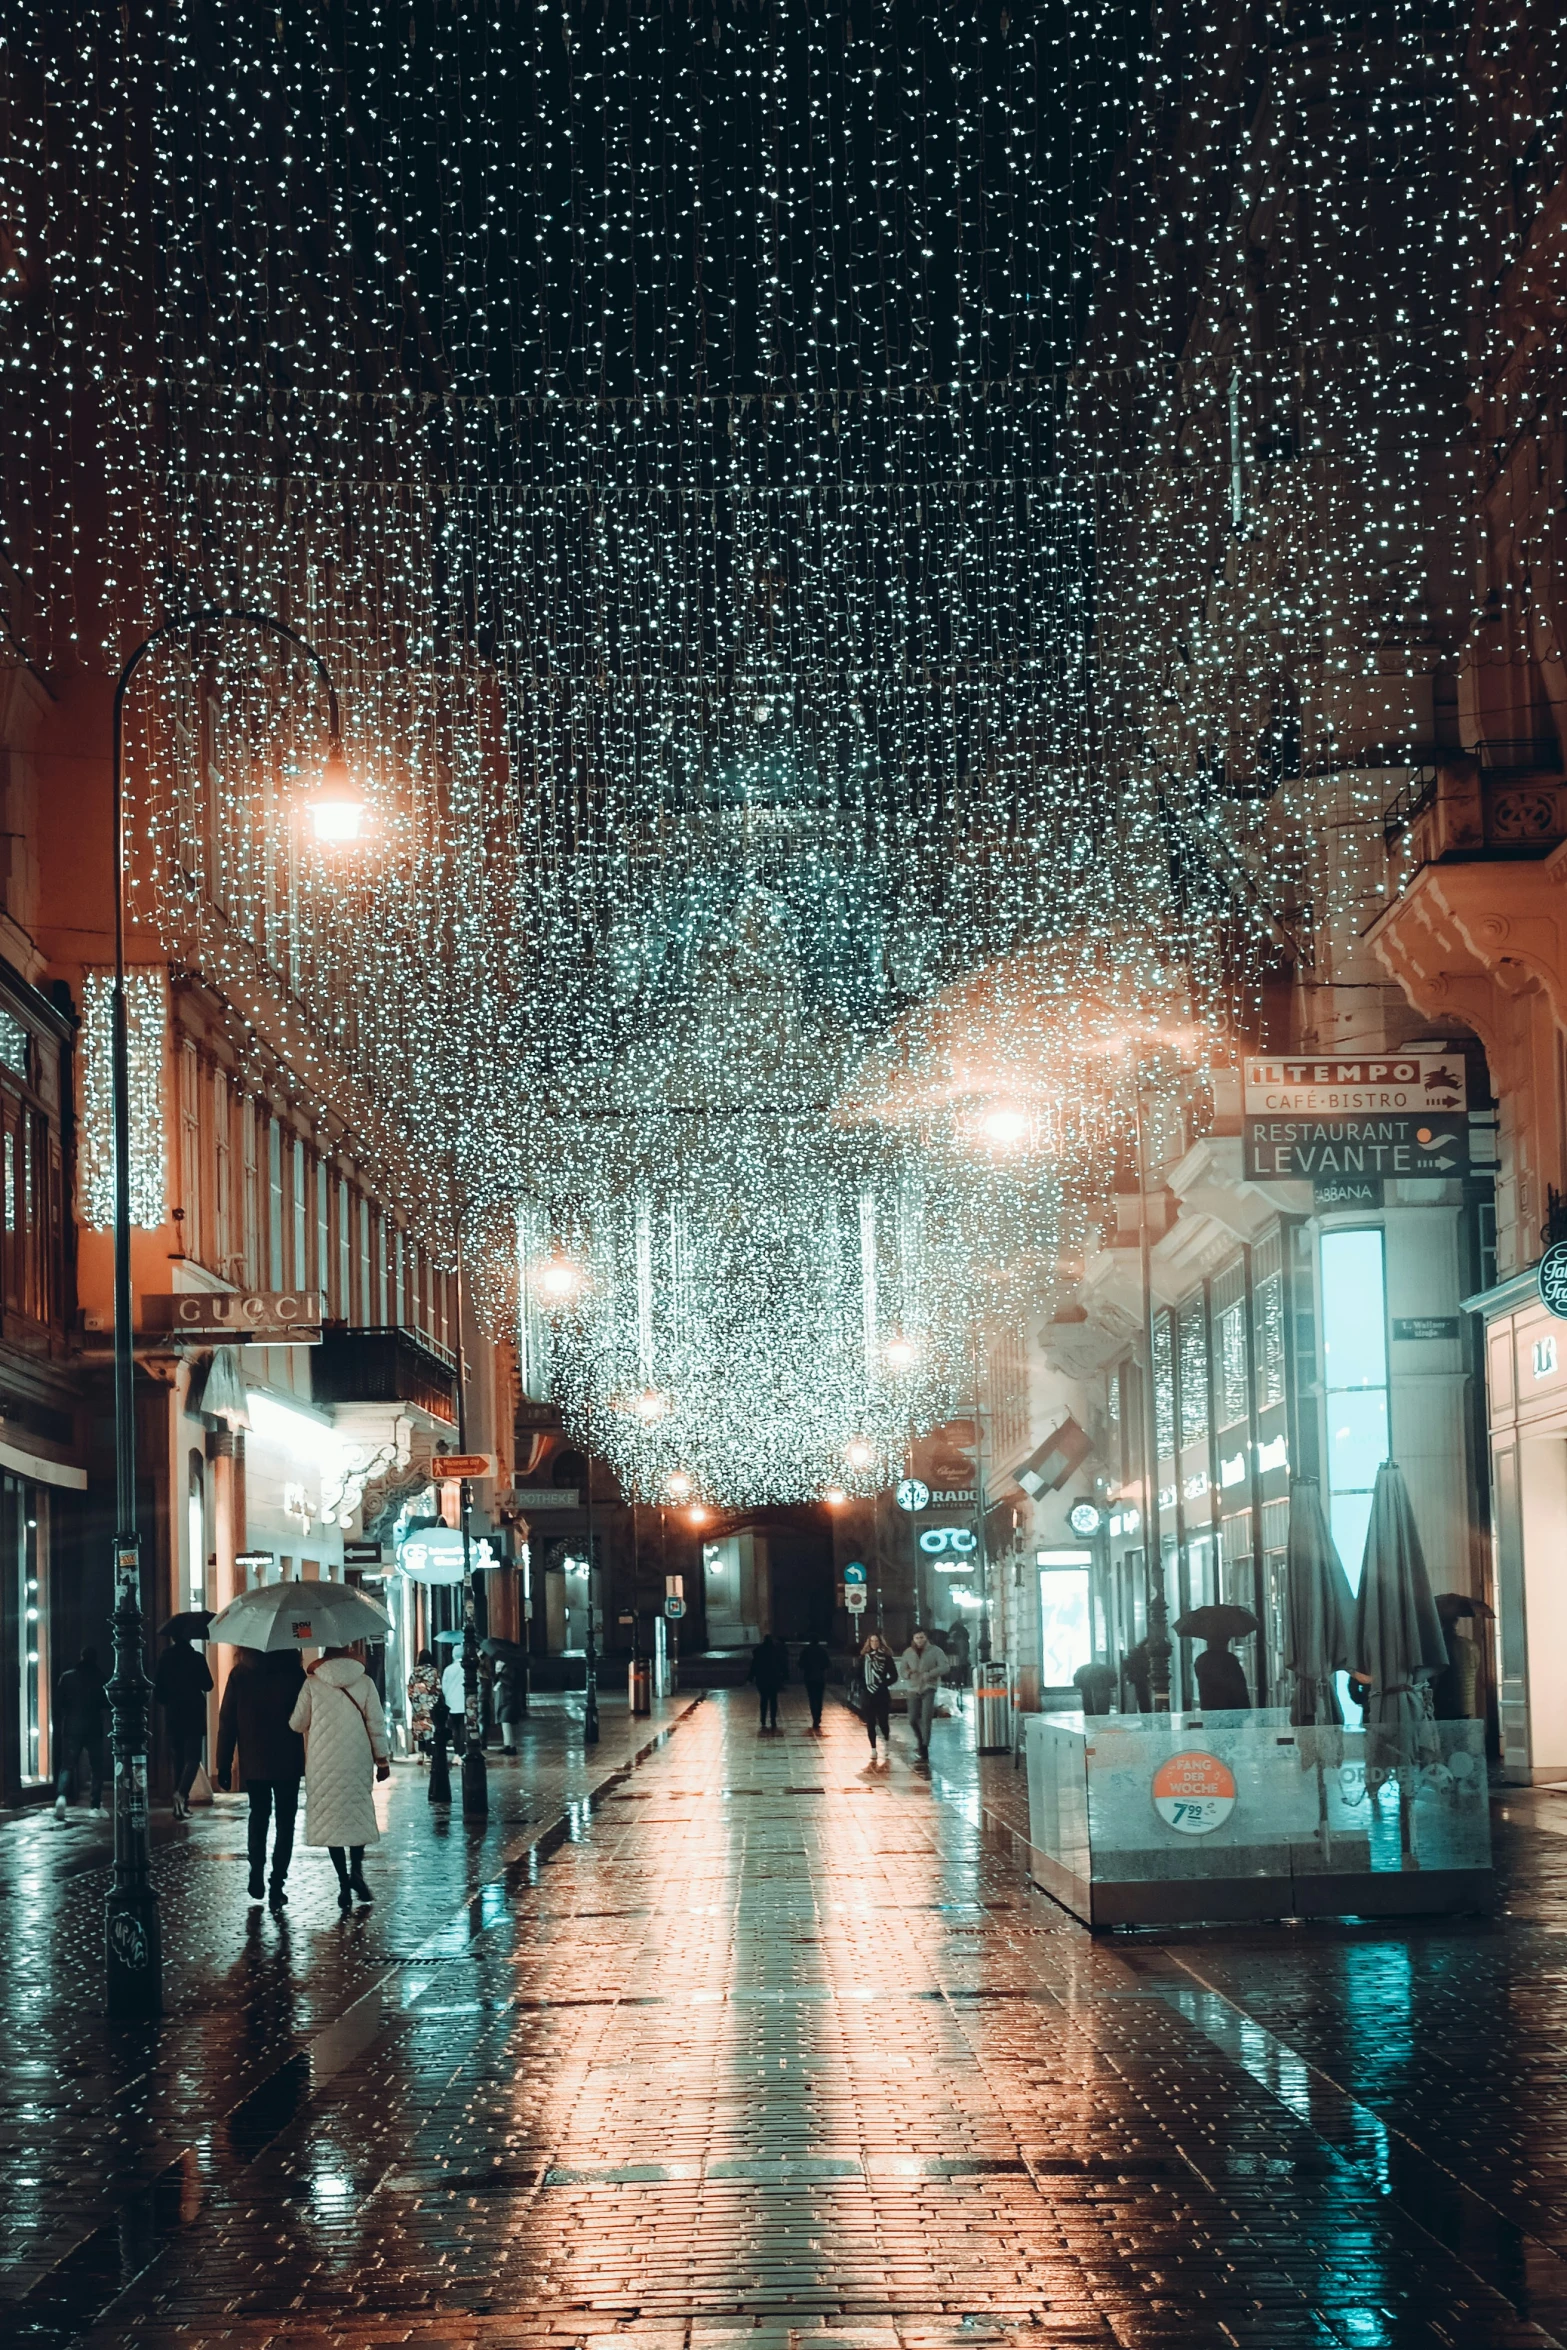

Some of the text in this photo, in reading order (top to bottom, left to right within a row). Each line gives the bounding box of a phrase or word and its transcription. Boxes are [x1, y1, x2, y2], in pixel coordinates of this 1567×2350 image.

[1253, 1064, 1415, 1084] IL TEMPO
[1254, 1122, 1409, 1142] RESTAURANT
[1254, 1145, 1411, 1173] LEVANTE
[1543, 1261, 1567, 1281] Ta
[179, 1296, 313, 1322] GUCCI
[505, 1491, 575, 1506] APOTHEKE
[1176, 1759, 1212, 1770] FANG
[1183, 1772, 1205, 1781] DER
[1170, 1783, 1218, 1793] WOCHE
